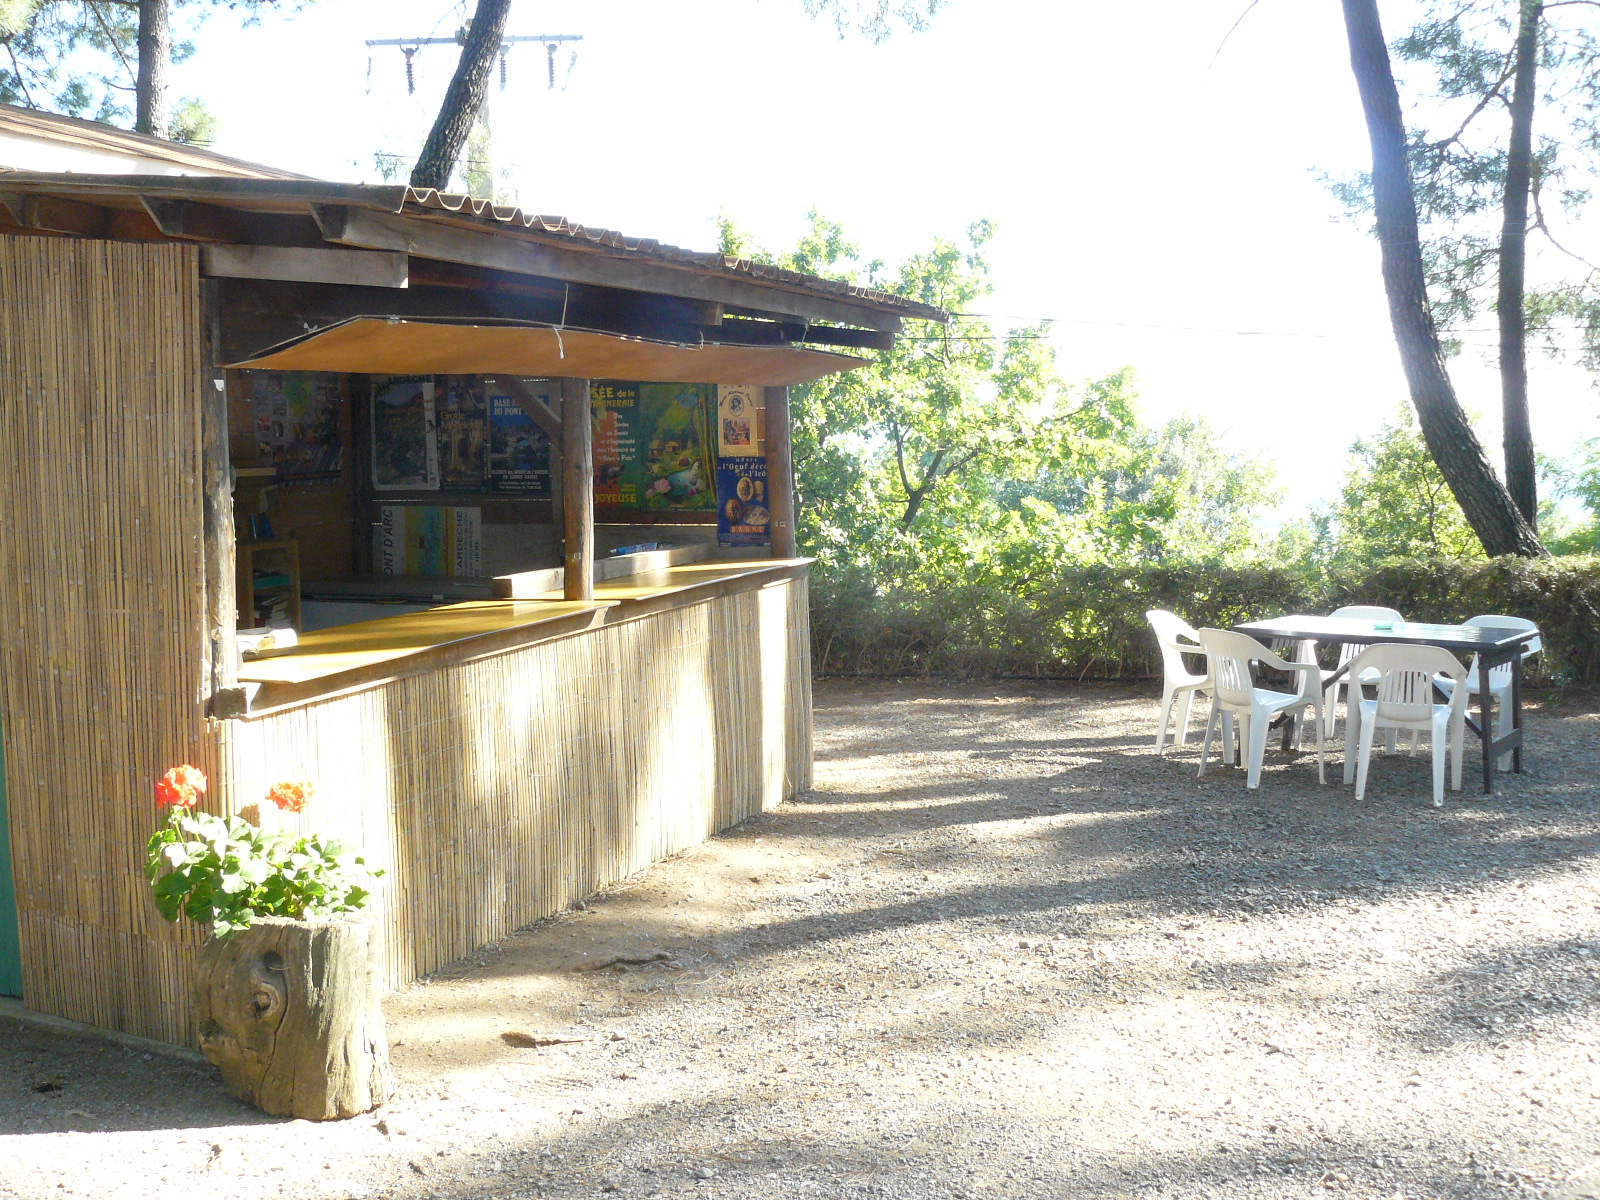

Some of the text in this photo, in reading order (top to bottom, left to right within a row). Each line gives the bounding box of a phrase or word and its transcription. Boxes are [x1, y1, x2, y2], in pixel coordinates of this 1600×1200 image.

[388, 375, 433, 384] ARDECHE
[590, 384, 614, 399] SÉE
[494, 399, 511, 407] BASE
[494, 408, 522, 416] DU PONT
[722, 462, 748, 470] l'Oeuf
[594, 493, 636, 504] JOYEUSE
[383, 509, 393, 576] ONT D'ARC
